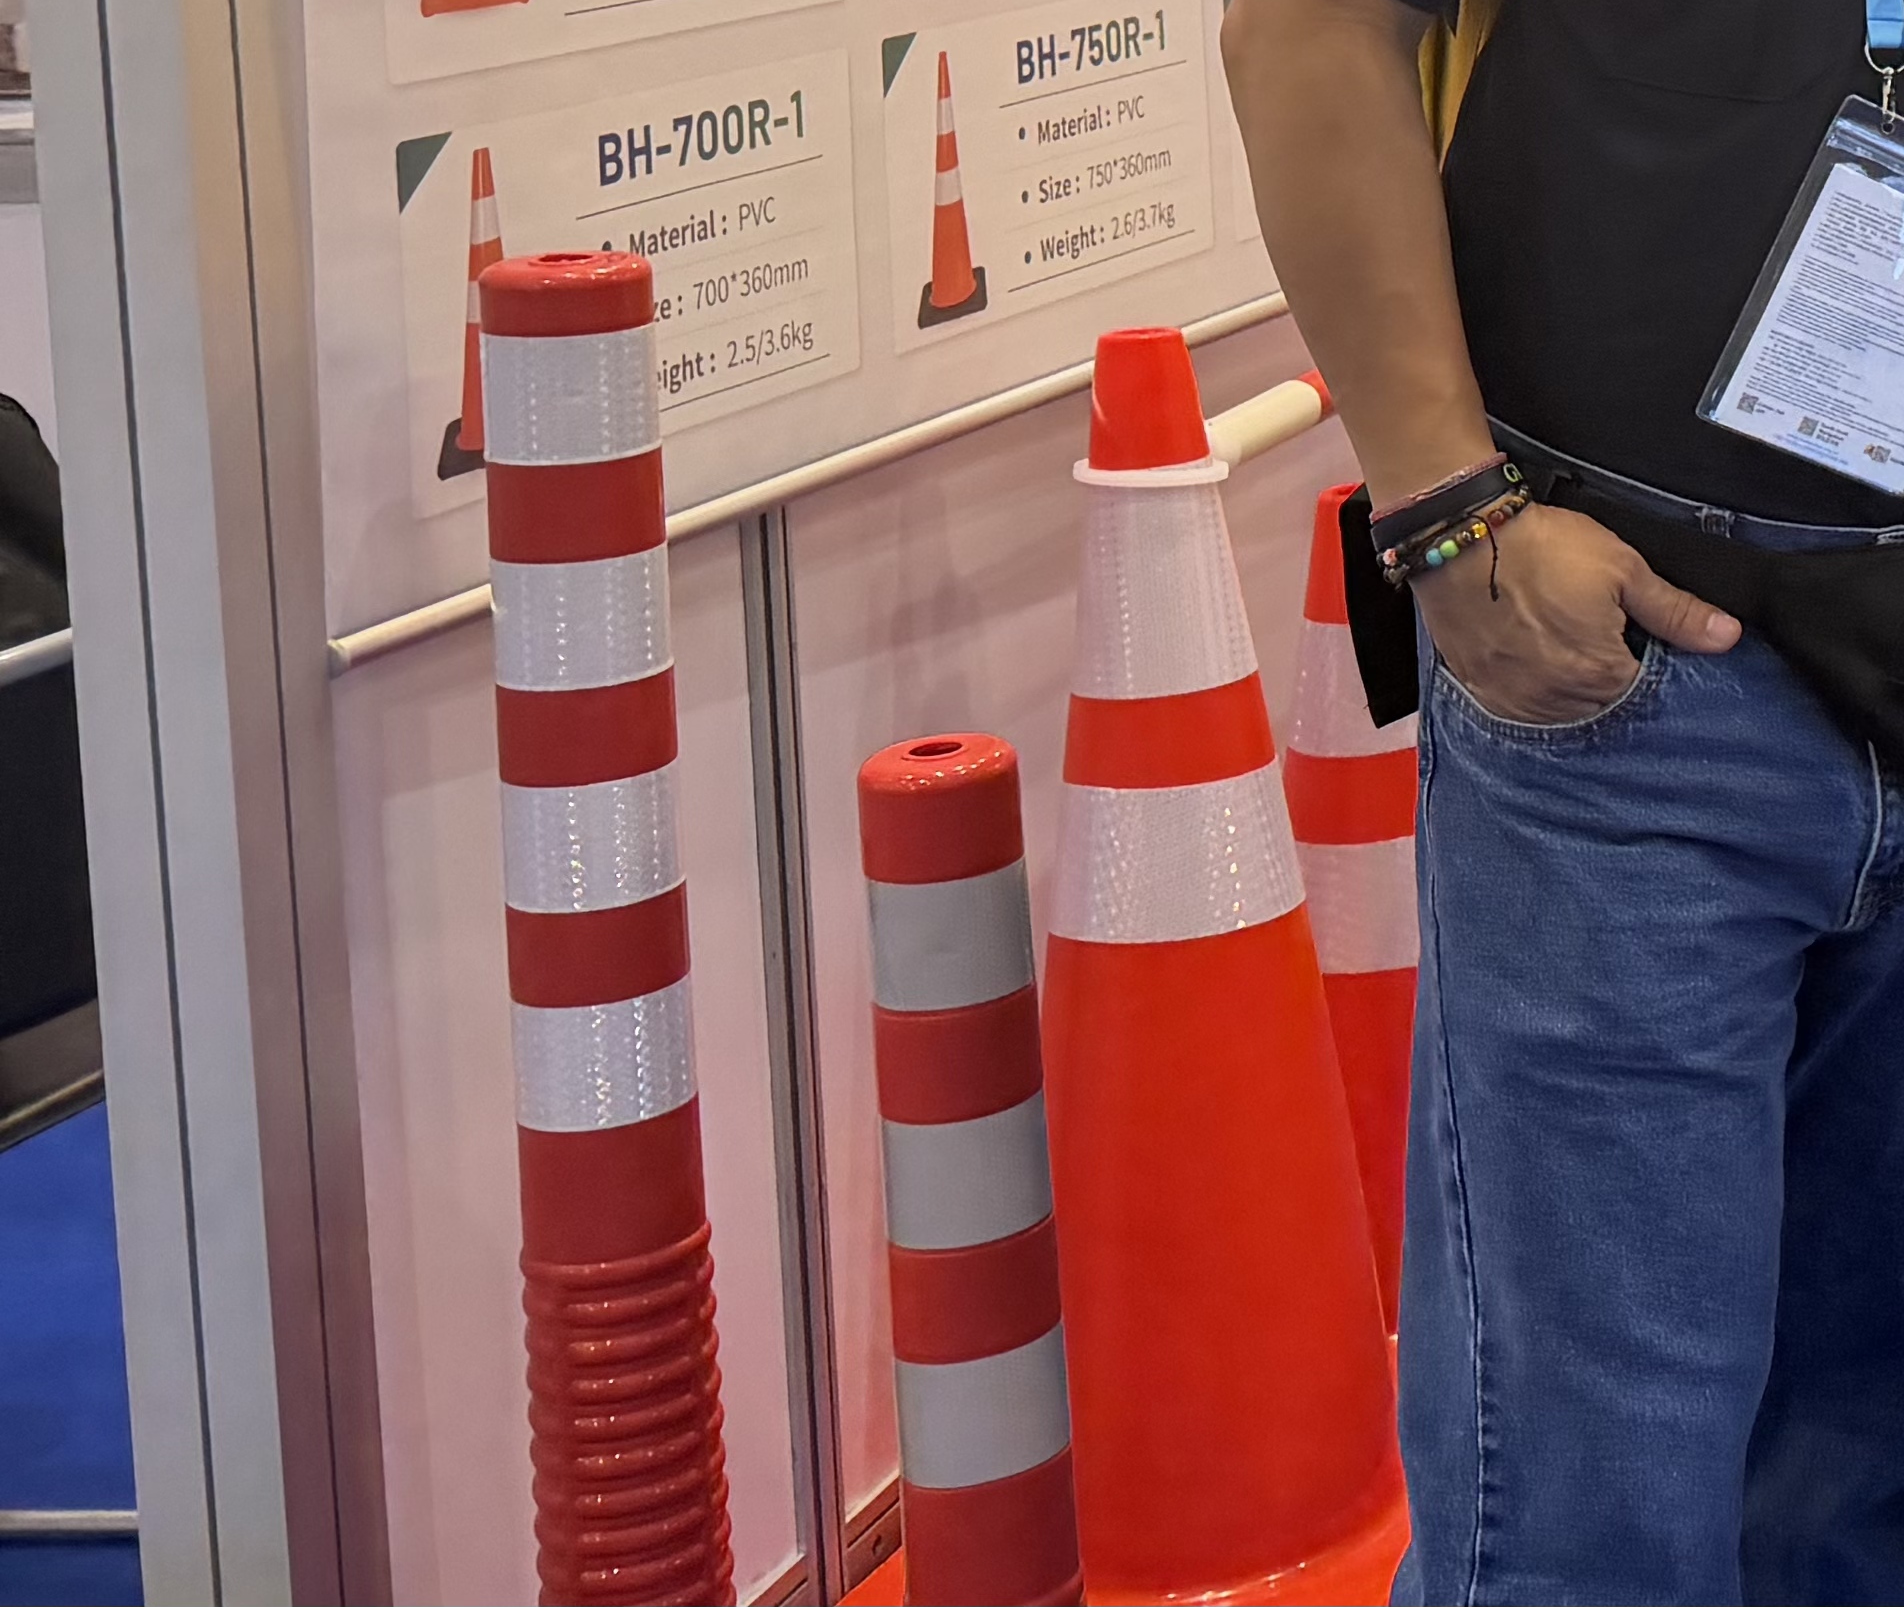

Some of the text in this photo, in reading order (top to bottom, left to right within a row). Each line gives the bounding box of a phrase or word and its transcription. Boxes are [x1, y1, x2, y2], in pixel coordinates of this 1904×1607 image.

[1016, 9, 1166, 85] BH-750R-1
[1117, 95, 1146, 125] PVC
[598, 90, 805, 187] BH-700R-1
[738, 196, 777, 231] PVC
[1110, 202, 1177, 242] 2.6/3.7kg
[726, 320, 815, 369] 2.5/3.6kg
